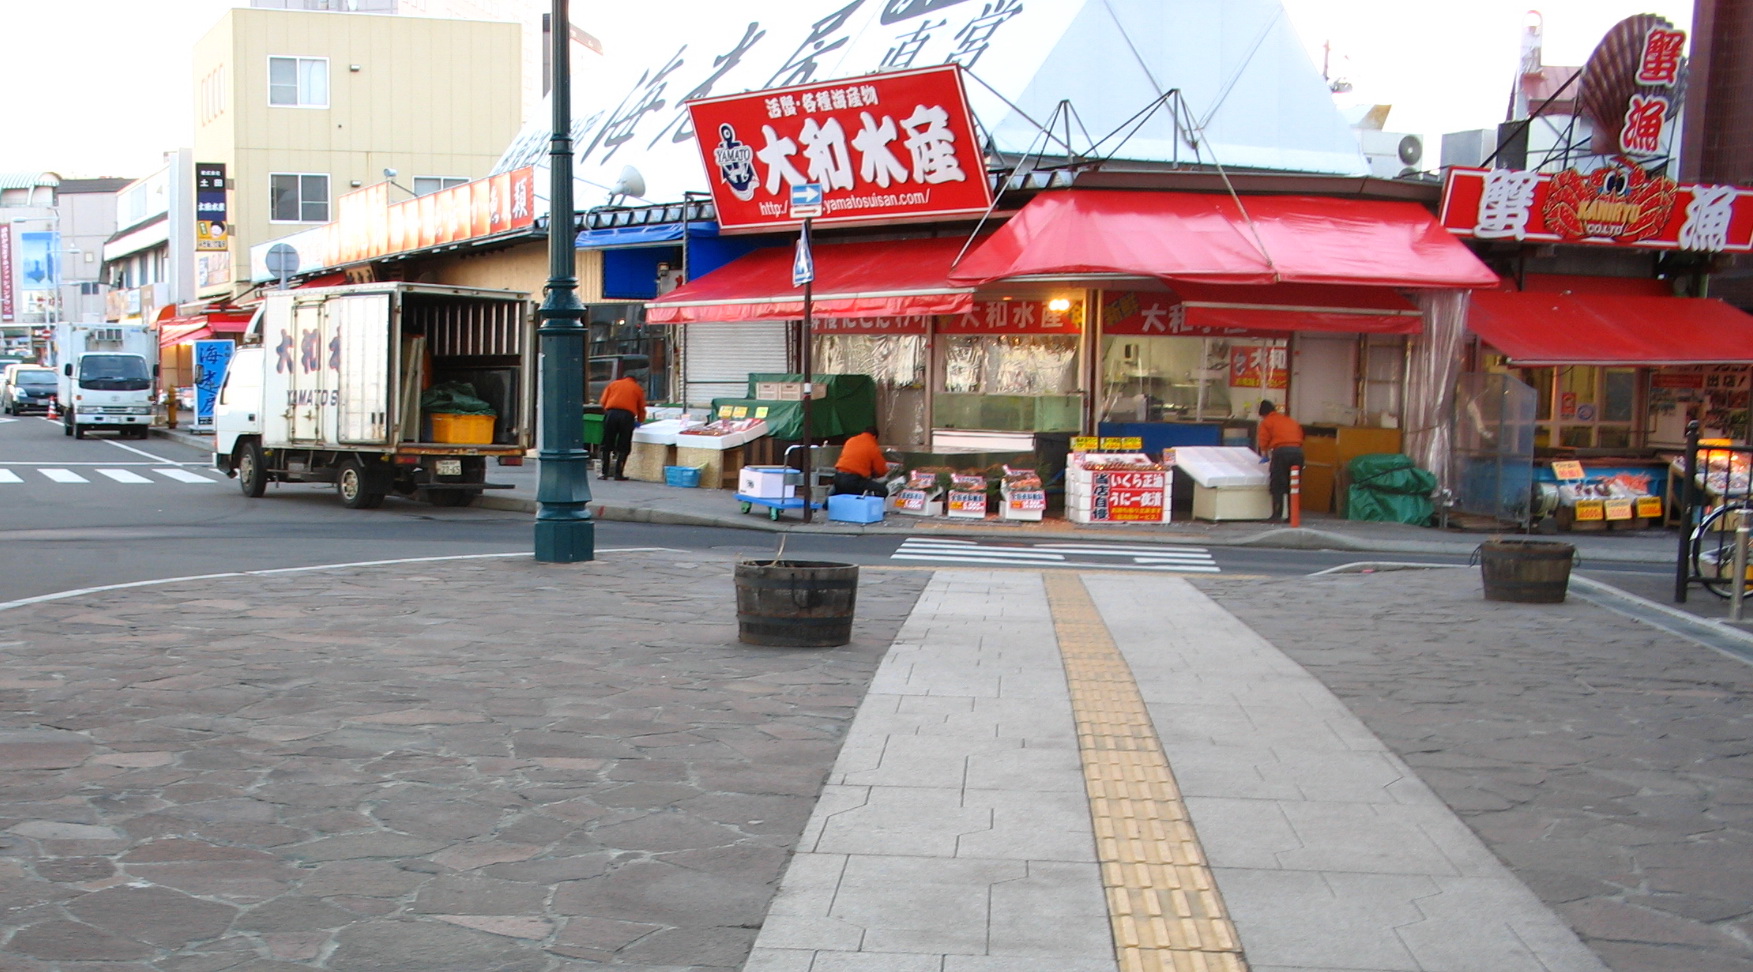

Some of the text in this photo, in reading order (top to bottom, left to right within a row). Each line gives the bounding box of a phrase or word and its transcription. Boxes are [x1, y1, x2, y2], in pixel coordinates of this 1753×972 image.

[716, 147, 751, 164] YAMATO
[756, 104, 966, 195] 大和水産
[759, 189, 931, 216] http:/.yamatosuisan.com/
[960, 301, 1064, 329] 大和水産
[1141, 302, 1247, 334] 大和
